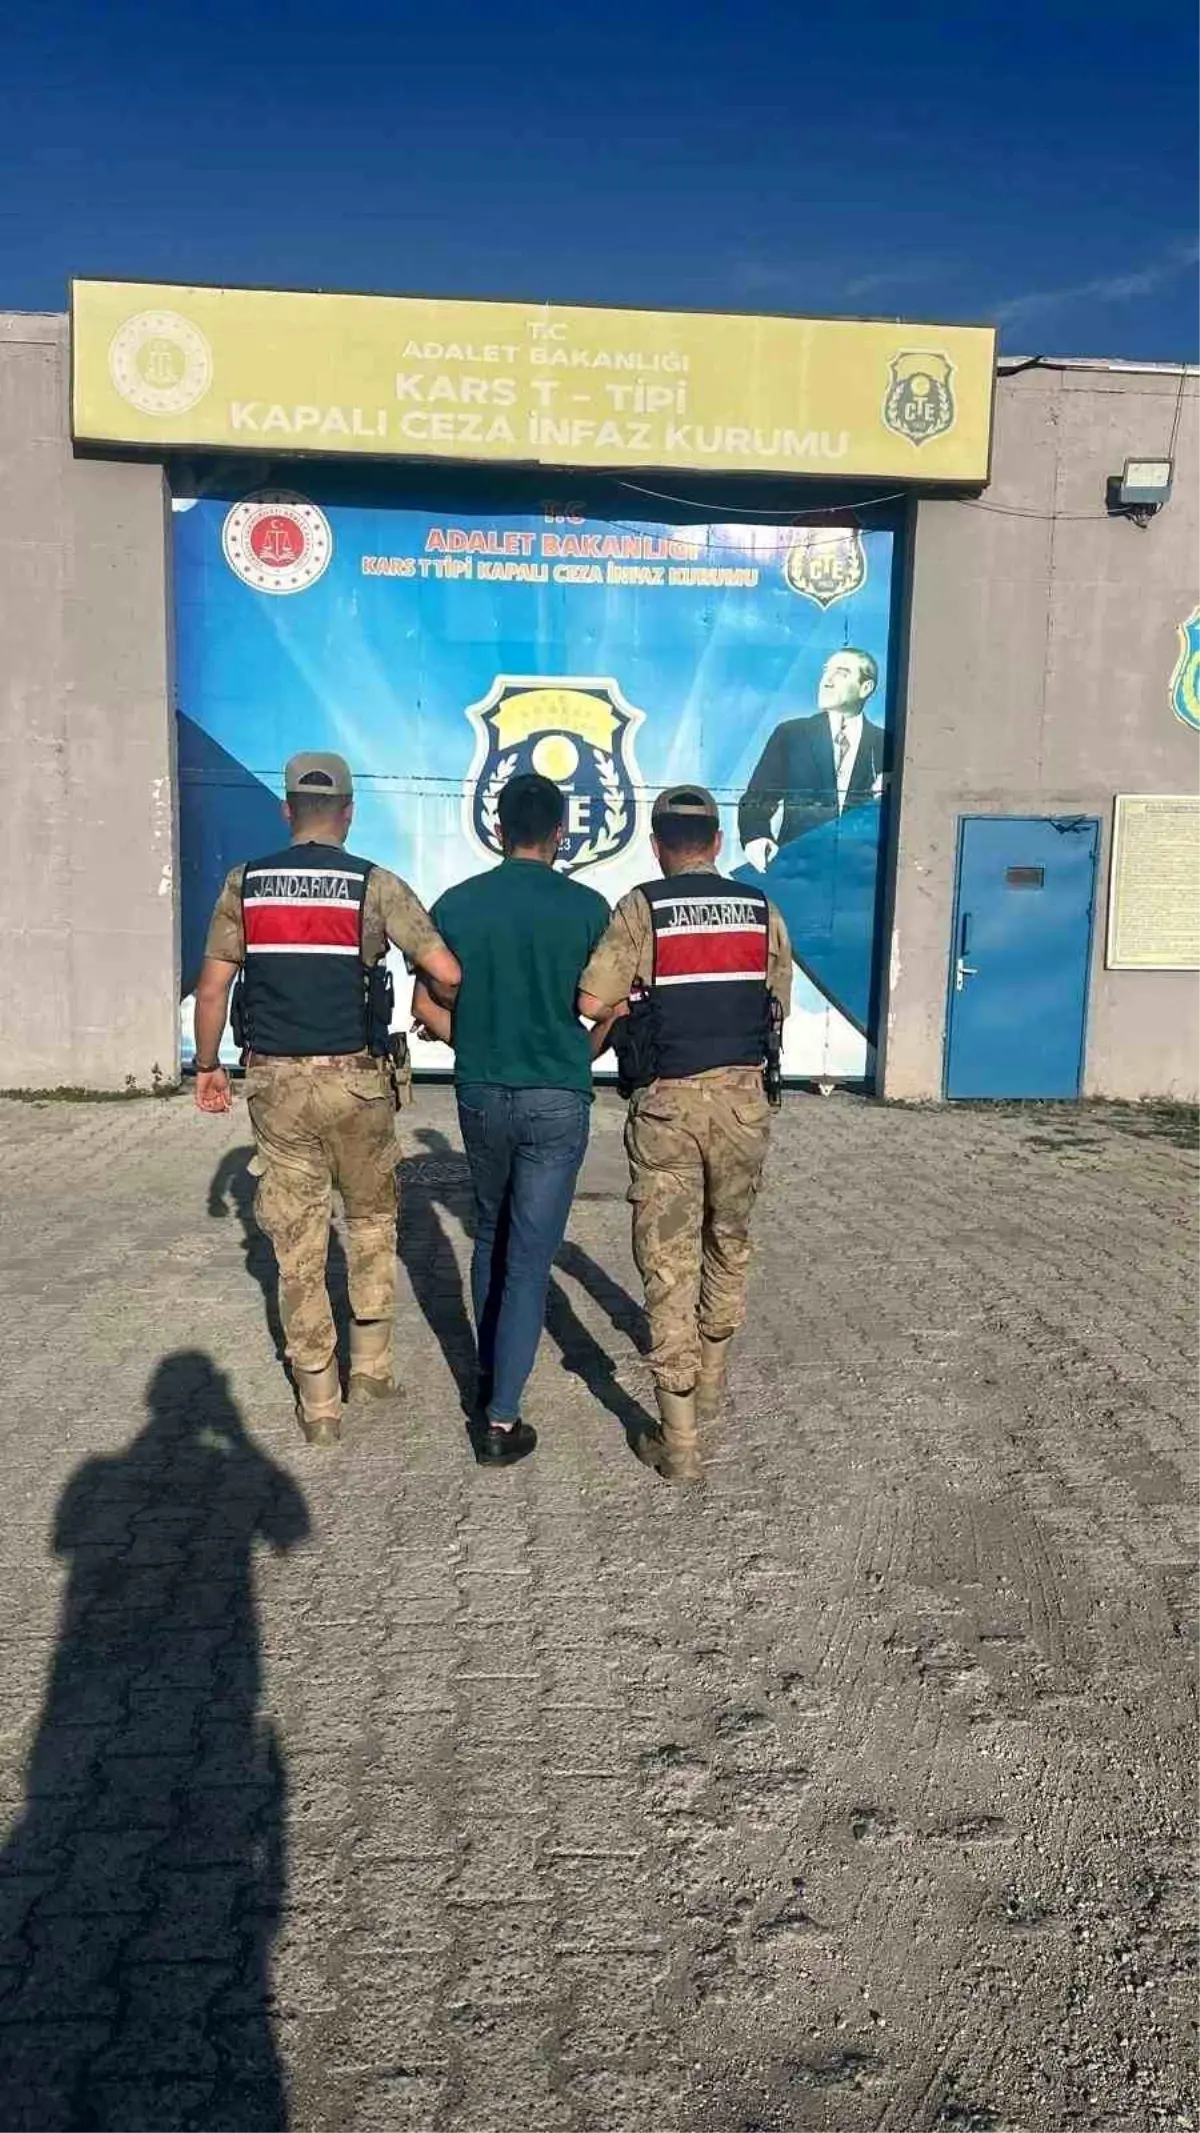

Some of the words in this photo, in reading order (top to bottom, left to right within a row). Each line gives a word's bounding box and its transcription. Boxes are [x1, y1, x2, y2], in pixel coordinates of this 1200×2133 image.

[402, 340, 519, 363] ADALET
[530, 348, 689, 372] BAKANLIĞI
[396, 372, 518, 406] KARS
[530, 380, 561, 406] T
[605, 378, 687, 415] TİPİ
[230, 402, 386, 437] KAPALI
[401, 410, 514, 443] CEZA
[528, 409, 651, 450] İNFAZ
[665, 424, 849, 459] KURUMU
[425, 528, 536, 556] ADALET
[362, 556, 416, 577] KARS
[477, 561, 549, 583] KAPALI
[553, 564, 603, 583] CEZA
[668, 567, 759, 588] KURUMU
[254, 875, 349, 898] JANDARMA
[668, 904, 757, 926] JANDARMA
